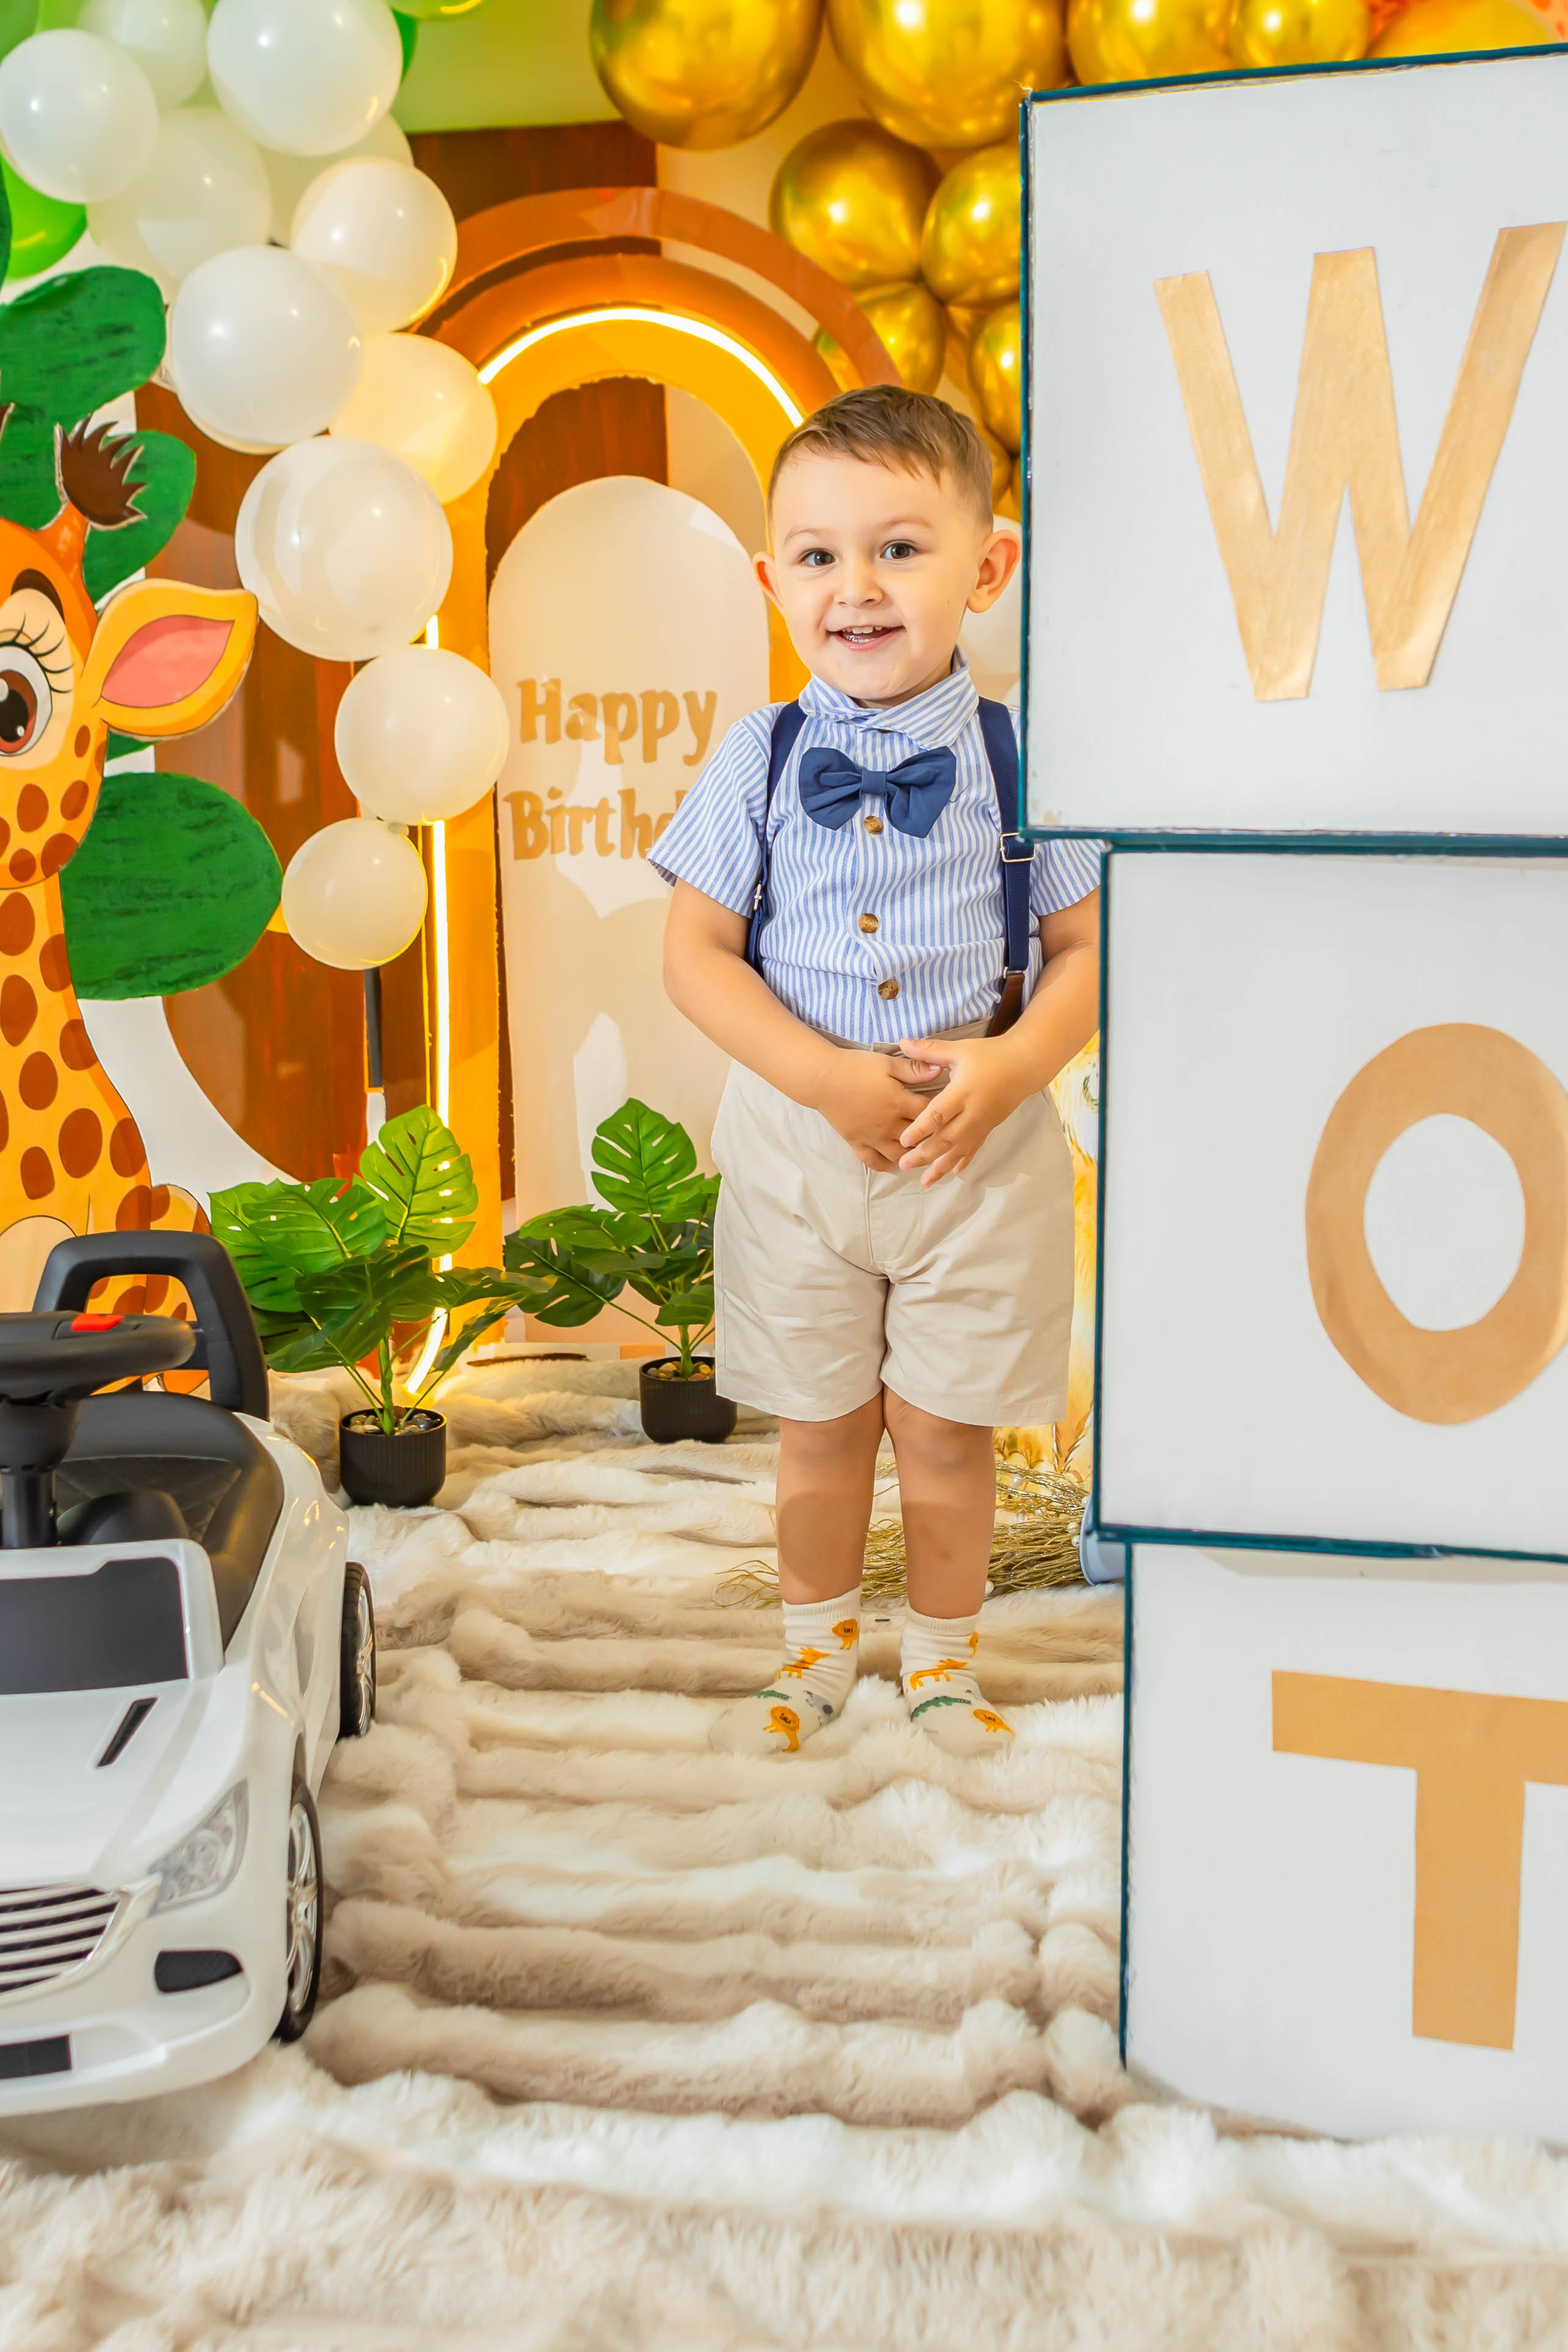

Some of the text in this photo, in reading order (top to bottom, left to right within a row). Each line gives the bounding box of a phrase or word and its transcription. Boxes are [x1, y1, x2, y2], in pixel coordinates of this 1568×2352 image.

[1153, 221, 1567, 702] W
[516, 679, 717, 766] Happy
[1305, 1022, 1568, 1425] O
[1272, 1668, 1568, 2051] T
